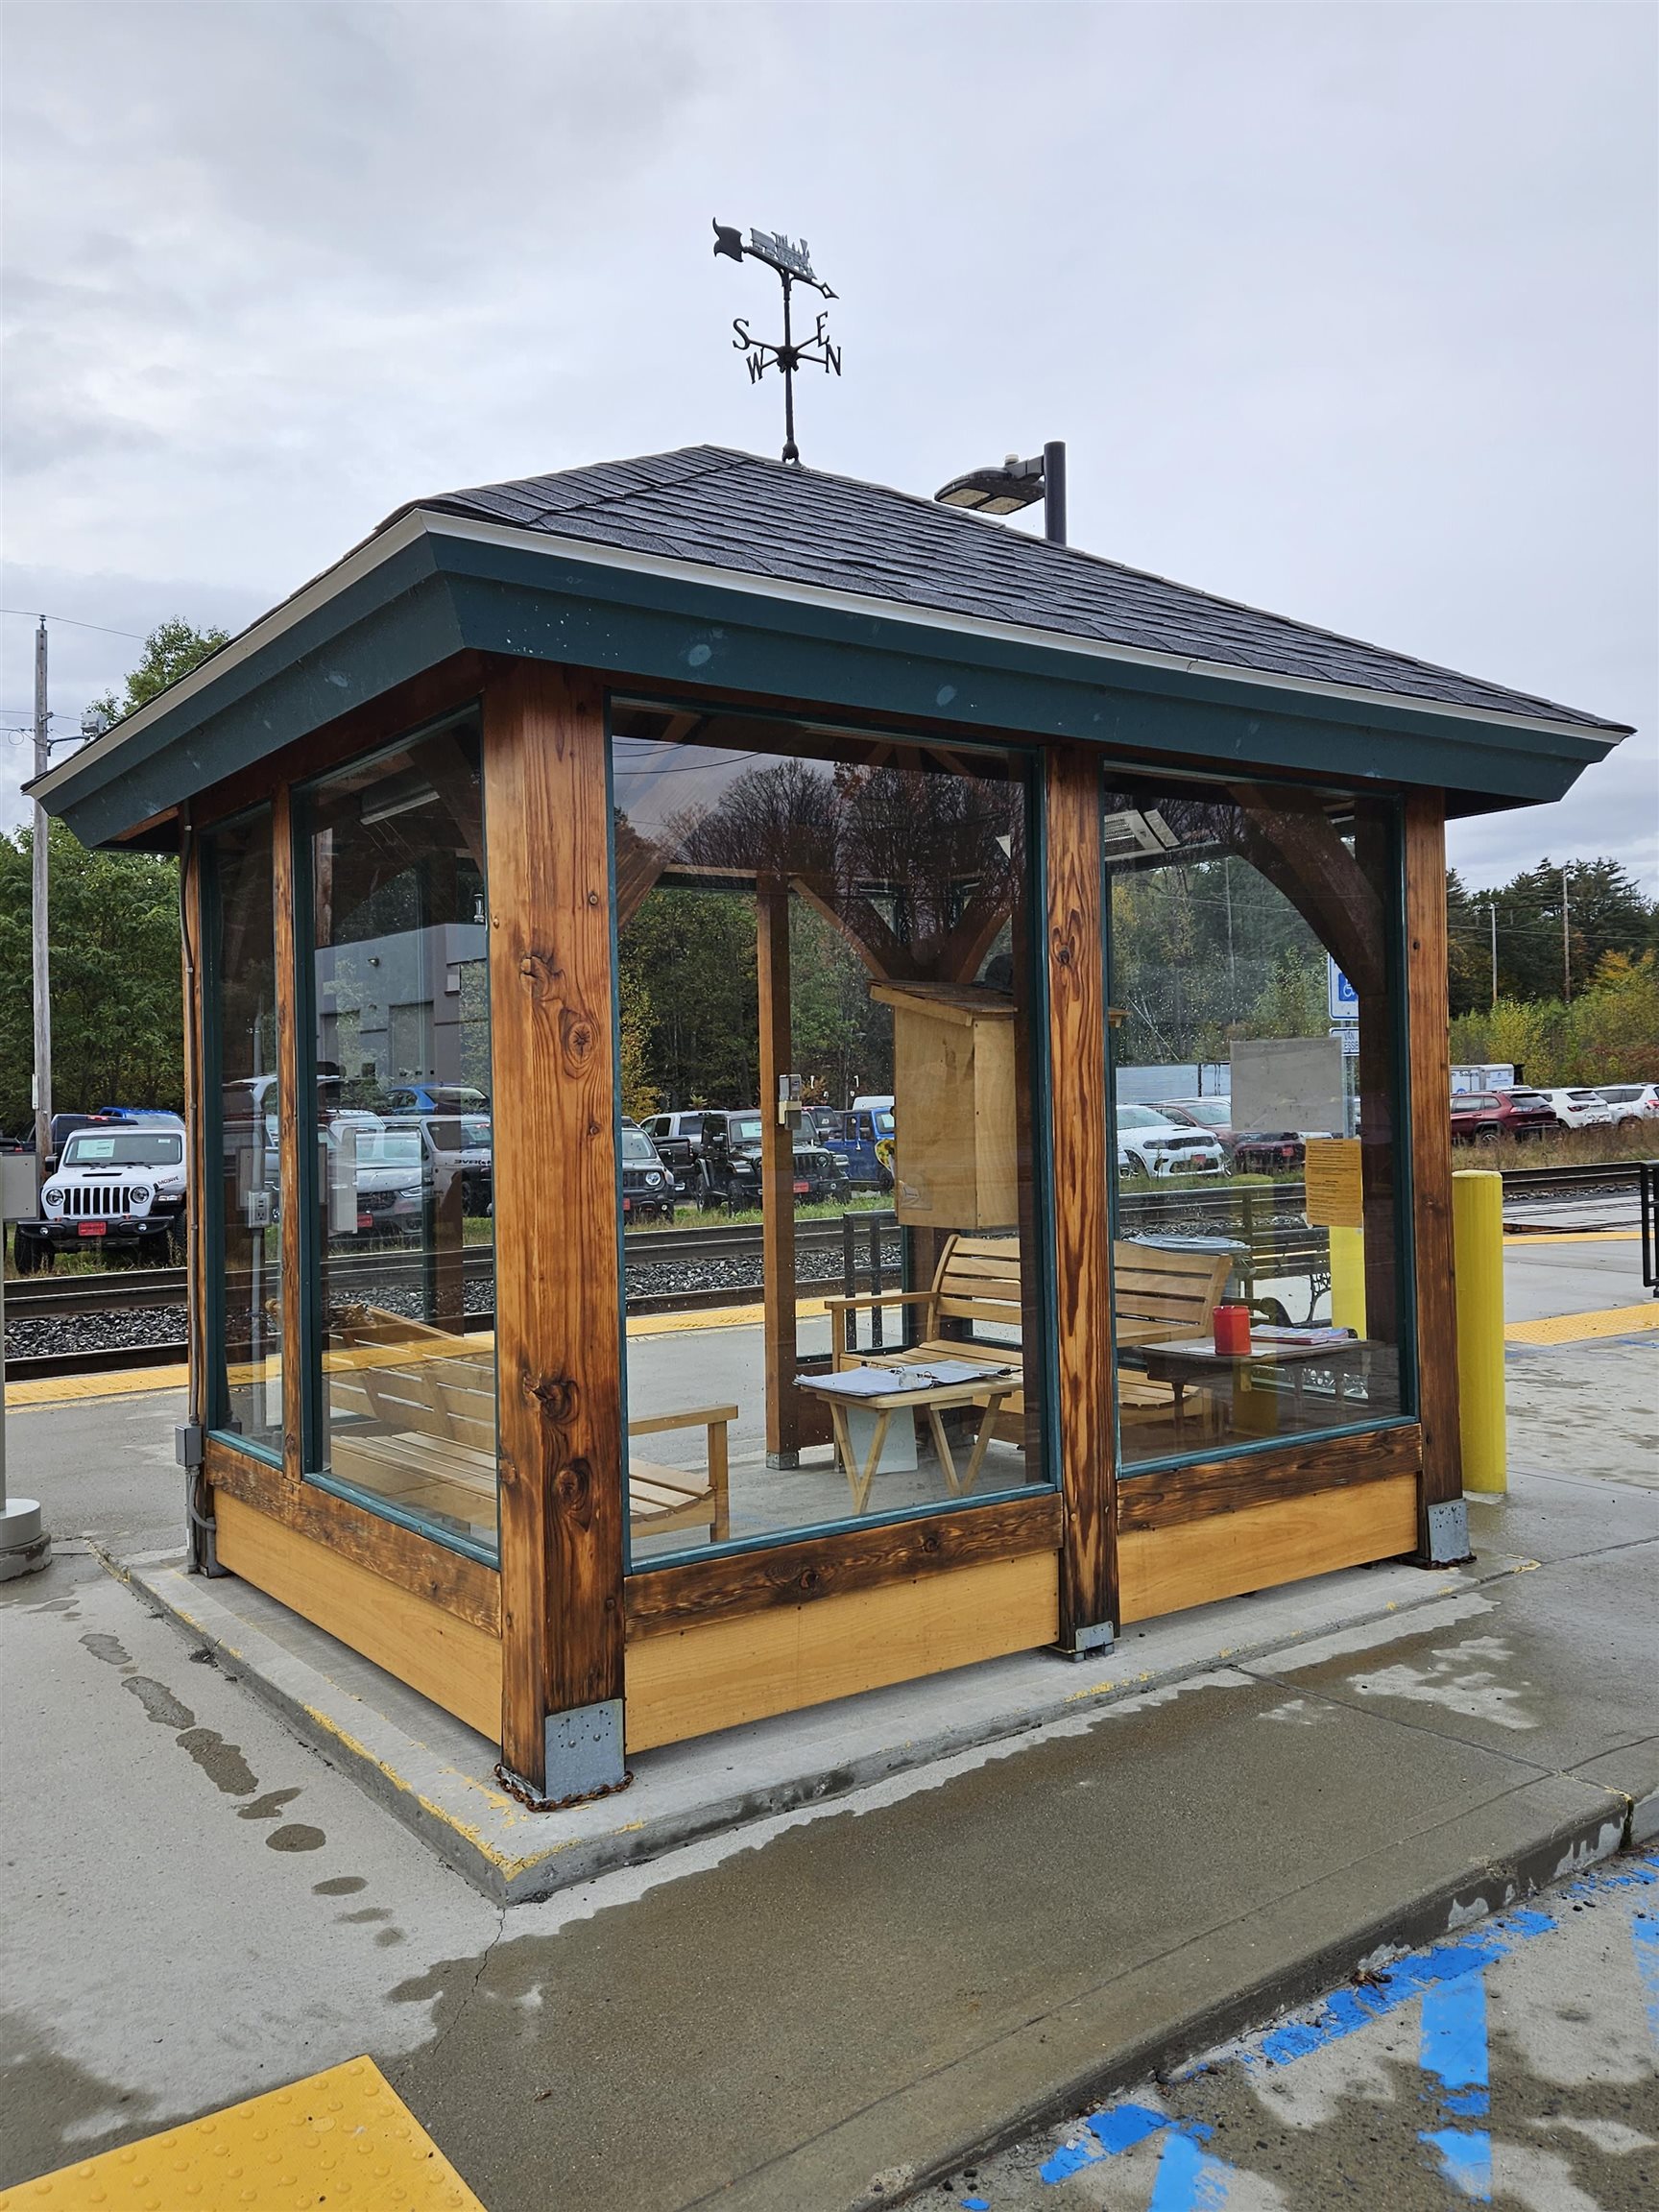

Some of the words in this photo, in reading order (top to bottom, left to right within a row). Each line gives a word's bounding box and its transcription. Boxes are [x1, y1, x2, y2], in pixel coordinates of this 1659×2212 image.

[732, 318, 749, 349] S
[816, 311, 830, 348] E
[746, 346, 764, 384] W
[825, 343, 841, 376] N
